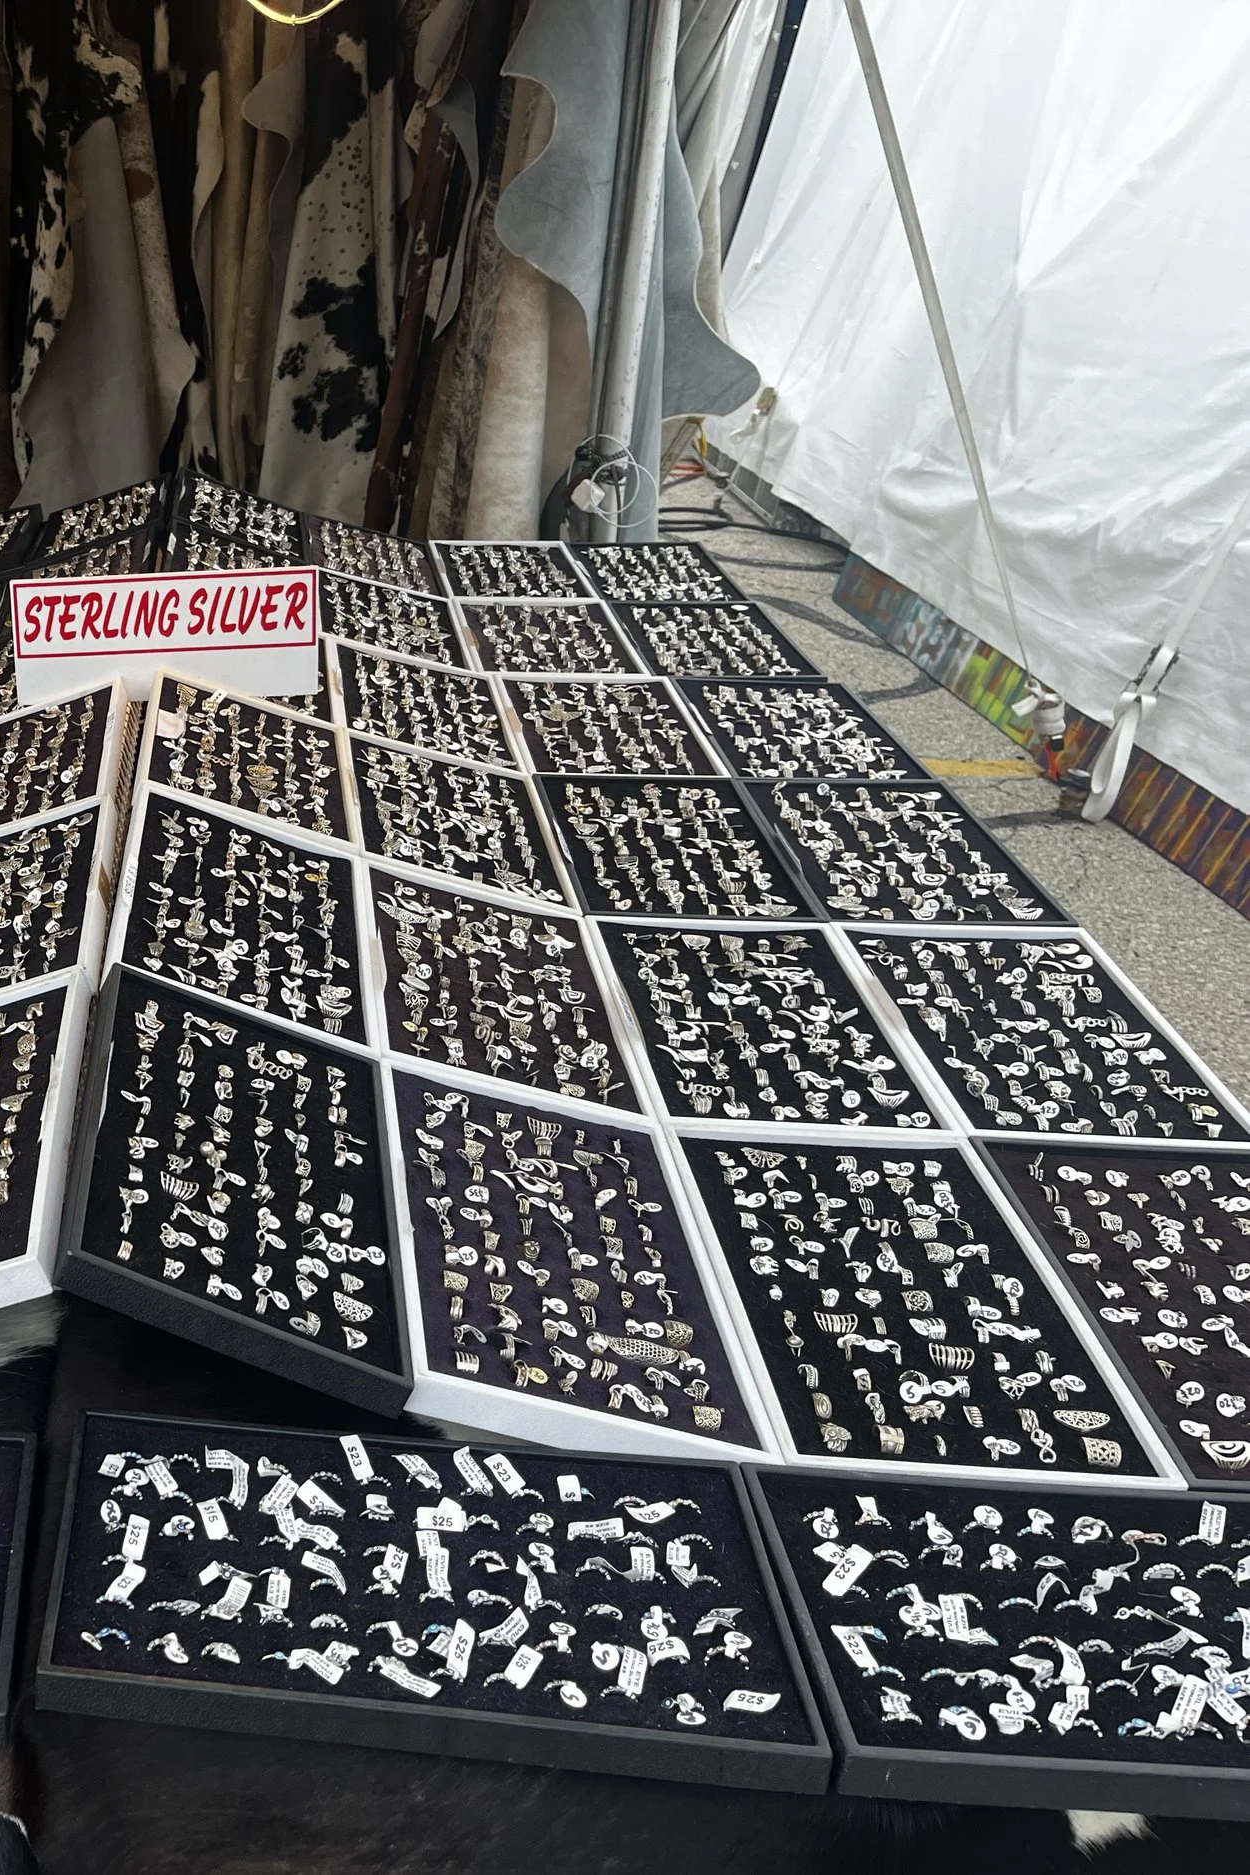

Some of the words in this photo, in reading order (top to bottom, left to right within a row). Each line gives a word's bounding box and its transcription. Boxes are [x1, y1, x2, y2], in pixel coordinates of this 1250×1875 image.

[23, 588, 180, 643] STERLING
[187, 581, 309, 636] SILVER
[906, 1385, 915, 1399] 5
[938, 1384, 948, 1394] 5
[347, 1446, 362, 1467] $23
[465, 1452, 478, 1470] EVIL
[477, 1471, 490, 1488] EYE
[492, 1462, 511, 1482] $23
[204, 1506, 219, 1522] $15
[432, 1514, 453, 1527] $25
[128, 1524, 142, 1546] $25
[432, 1533, 440, 1546] EVI
[313, 1555, 332, 1565] EVIL
[834, 1557, 856, 1580] $23
[942, 1600, 950, 1612] EYE
[947, 1614, 955, 1634] EVIL
[454, 1634, 468, 1662] $25
[648, 1639, 675, 1655] $25
[844, 1635, 862, 1655] $23
[516, 1653, 532, 1670] $25
[594, 1649, 610, 1666] 5
[634, 1670, 642, 1688] EYE
[736, 1692, 765, 1706] $25
[1179, 1686, 1188, 1701] SIZE
[1196, 1688, 1205, 1706] EVIL
